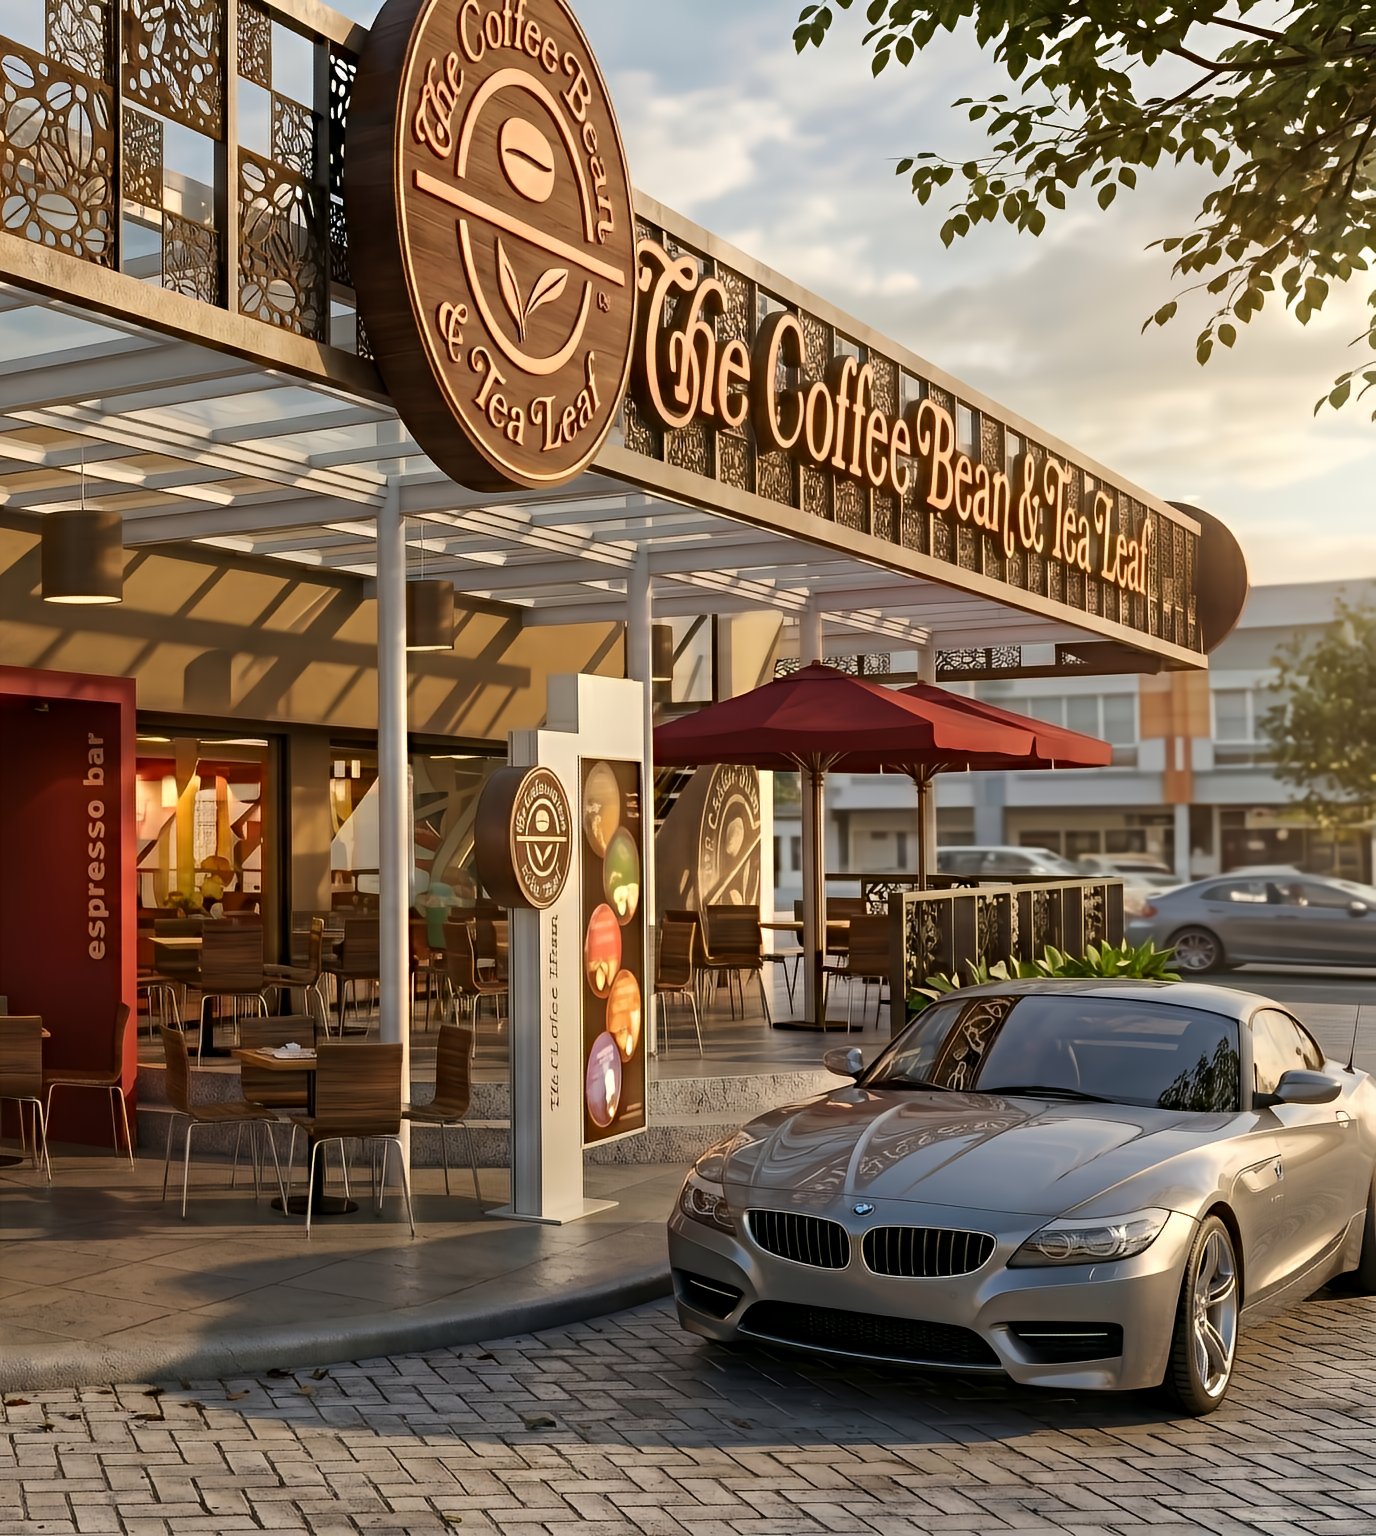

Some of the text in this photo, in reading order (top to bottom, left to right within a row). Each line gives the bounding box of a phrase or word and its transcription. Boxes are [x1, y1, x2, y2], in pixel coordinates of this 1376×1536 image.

[415, 0, 617, 244] The Coffee Bean
[436, 300, 602, 451] & Tea Leaf
[636, 239, 1152, 596] The Coffee Bean & Tea Leaf
[82, 732, 110, 961] espresso bar
